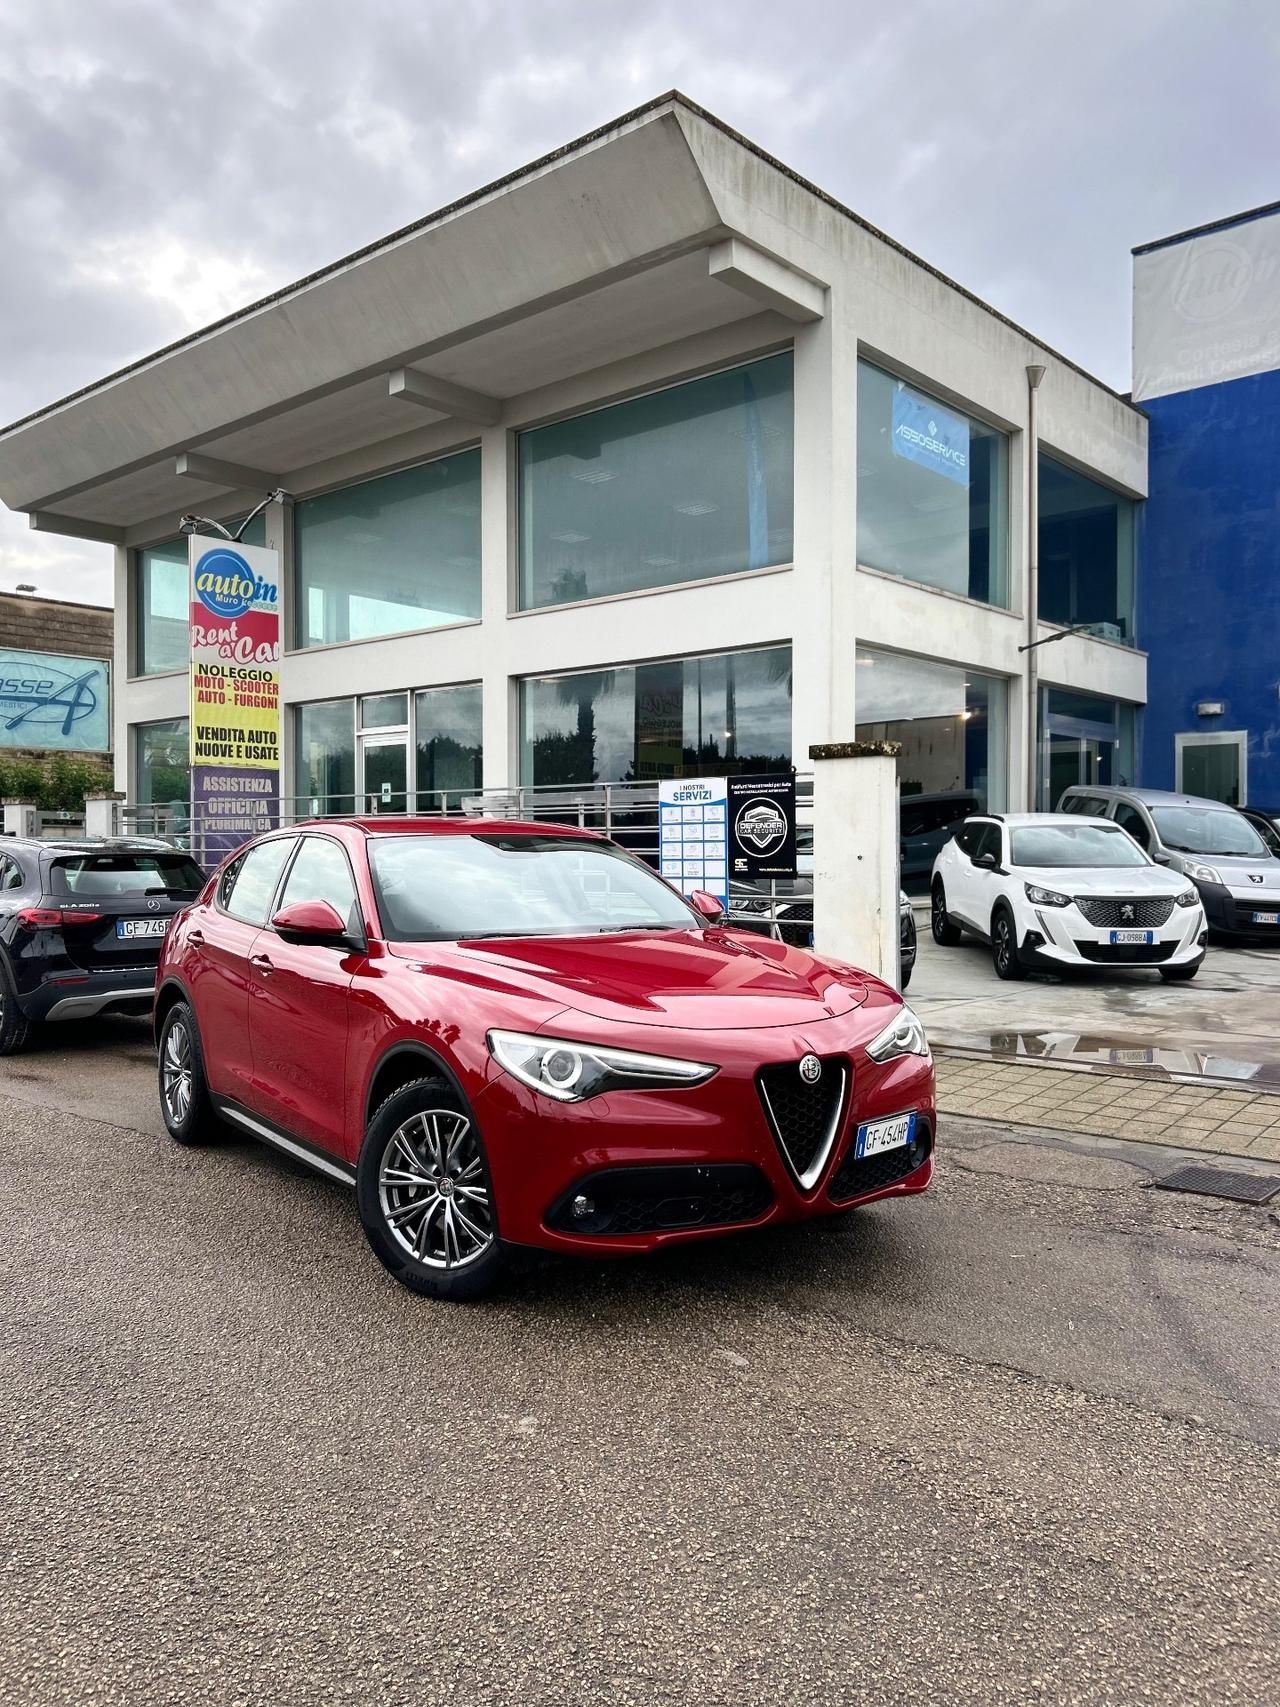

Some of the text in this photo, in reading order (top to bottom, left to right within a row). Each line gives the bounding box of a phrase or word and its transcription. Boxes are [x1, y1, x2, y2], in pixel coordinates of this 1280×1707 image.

[216, 594, 239, 605] Muro
[192, 621, 238, 648] Rent
[198, 664, 273, 682] NOLEGGIO
[194, 675, 225, 690] MOTO
[233, 679, 279, 695] SCOOTER
[198, 690, 225, 704] AUTO
[234, 694, 278, 709] FURGONI
[196, 726, 277, 745] VENDITA AUTO
[195, 742, 279, 760] NUOVE E USATE
[203, 776, 273, 793] ASSISTENZA
[673, 790, 712, 802] SERVIZI
[204, 816, 272, 831] PLURIMACA
